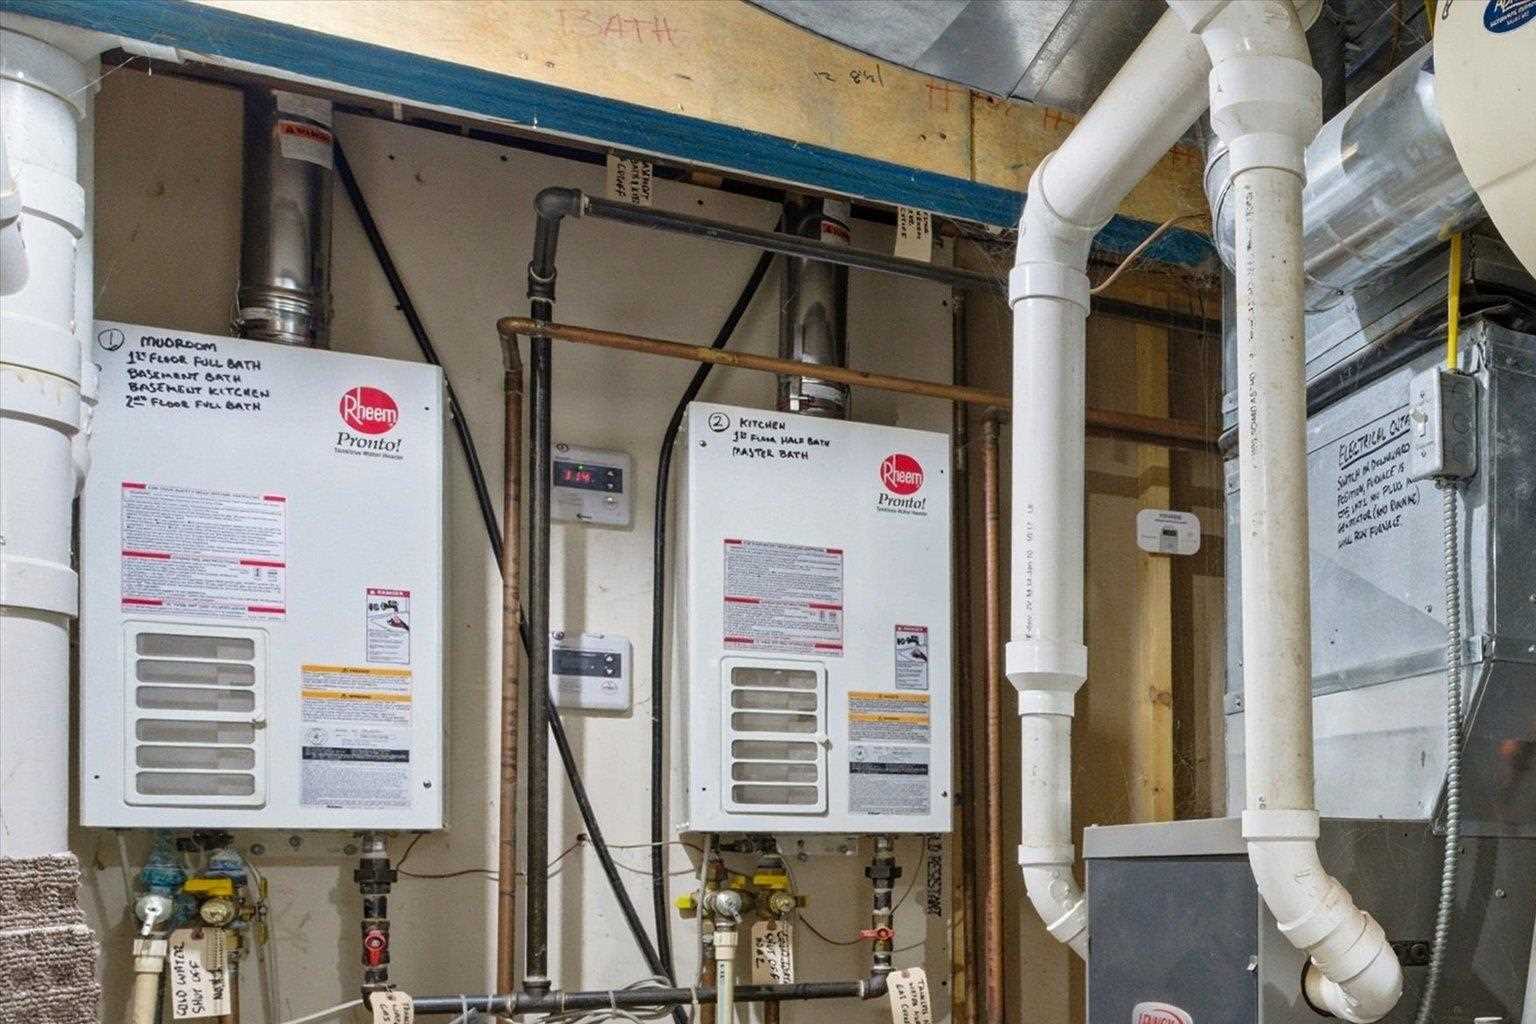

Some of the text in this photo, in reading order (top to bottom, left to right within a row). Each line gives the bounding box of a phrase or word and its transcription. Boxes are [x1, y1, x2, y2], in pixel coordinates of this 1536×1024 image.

[141, 336, 217, 351] MUDROOM
[150, 352, 187, 364] FLOOR
[194, 356, 223, 368] FULL
[227, 359, 262, 370] BATH
[127, 368, 241, 383] BASEMENT BATH
[128, 382, 270, 398] BASEMENT KITCHEN
[151, 398, 189, 408] FLOOR
[195, 400, 221, 409] FULL
[226, 401, 261, 411] BATH
[344, 387, 397, 426] Rheem
[740, 417, 786, 430] KITCHEN
[337, 432, 402, 452] Pronto!
[807, 437, 831, 447] BATH
[1339, 427, 1386, 467] ELECTRICAL
[733, 447, 809, 460] MASTER BATH
[882, 455, 923, 488] Rheem
[878, 493, 927, 510] Pronto!
[173, 942, 185, 985] WATER
